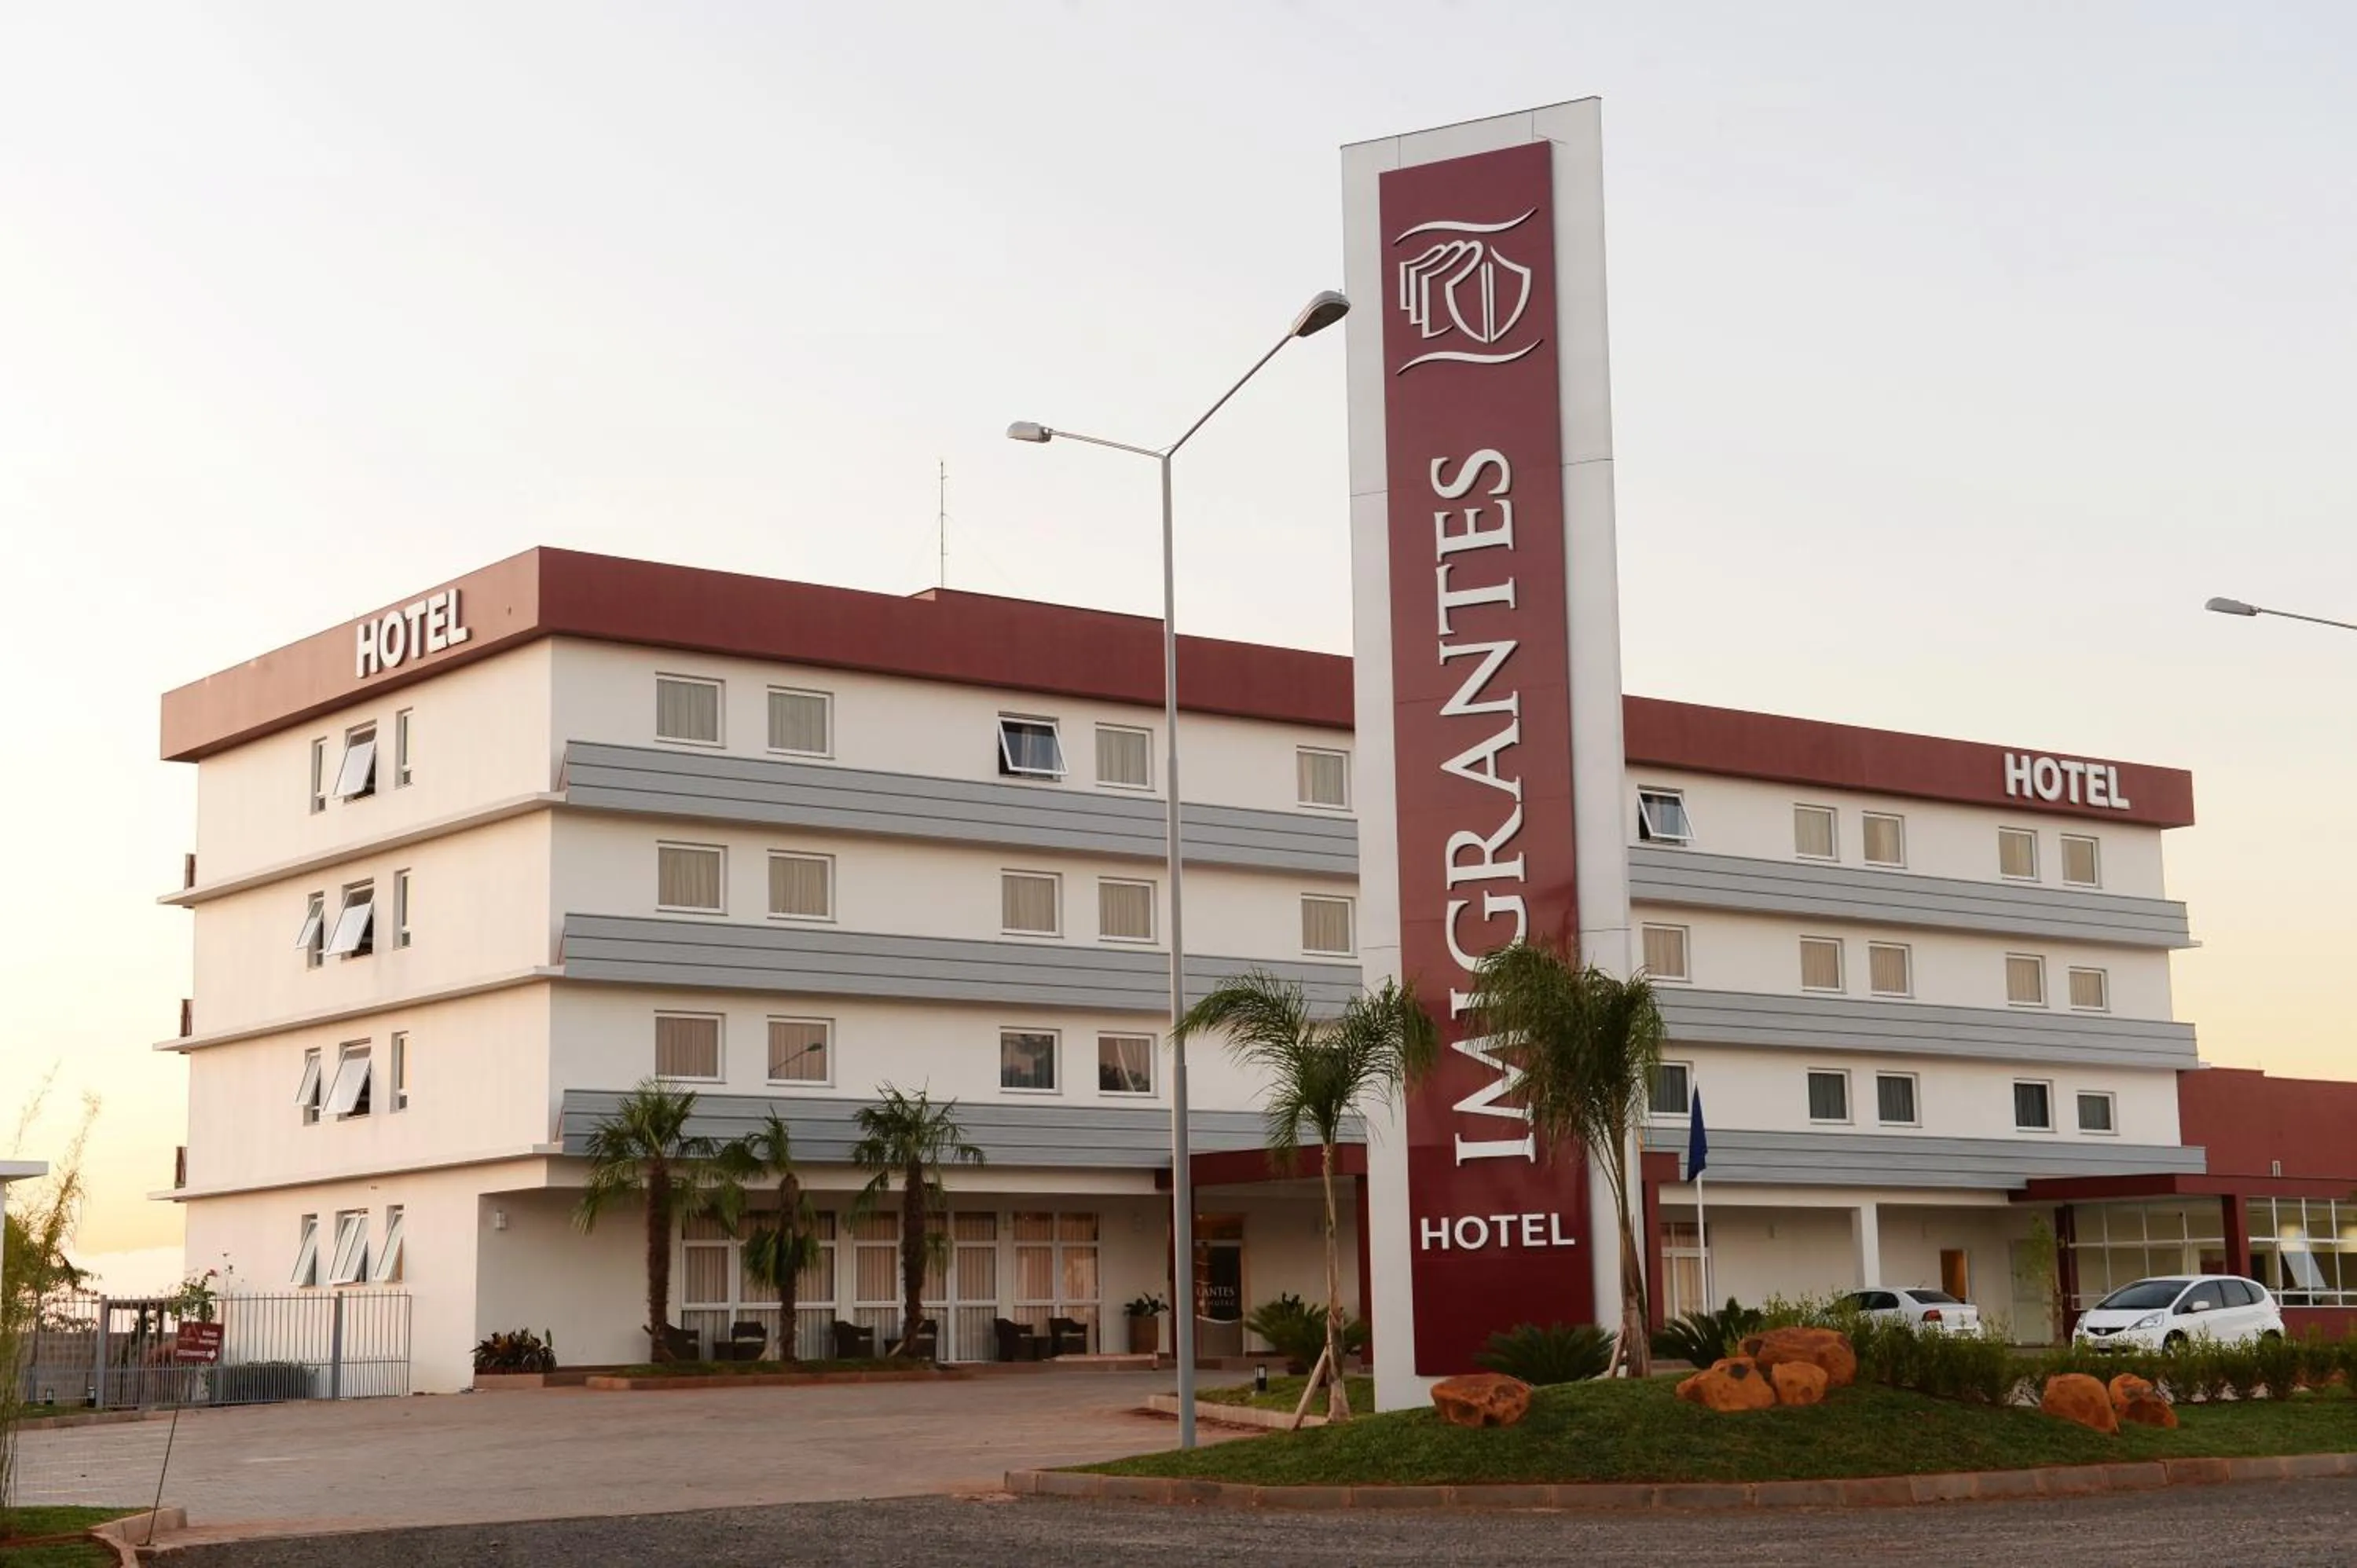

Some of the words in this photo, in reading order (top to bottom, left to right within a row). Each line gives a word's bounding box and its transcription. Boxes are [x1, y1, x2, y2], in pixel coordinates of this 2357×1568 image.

[356, 588, 469, 679] HOTEL
[1430, 449, 1536, 1167] IMIGRANTES
[2004, 752, 2132, 810] HOTEL
[1420, 1213, 1575, 1251] HOTEL
